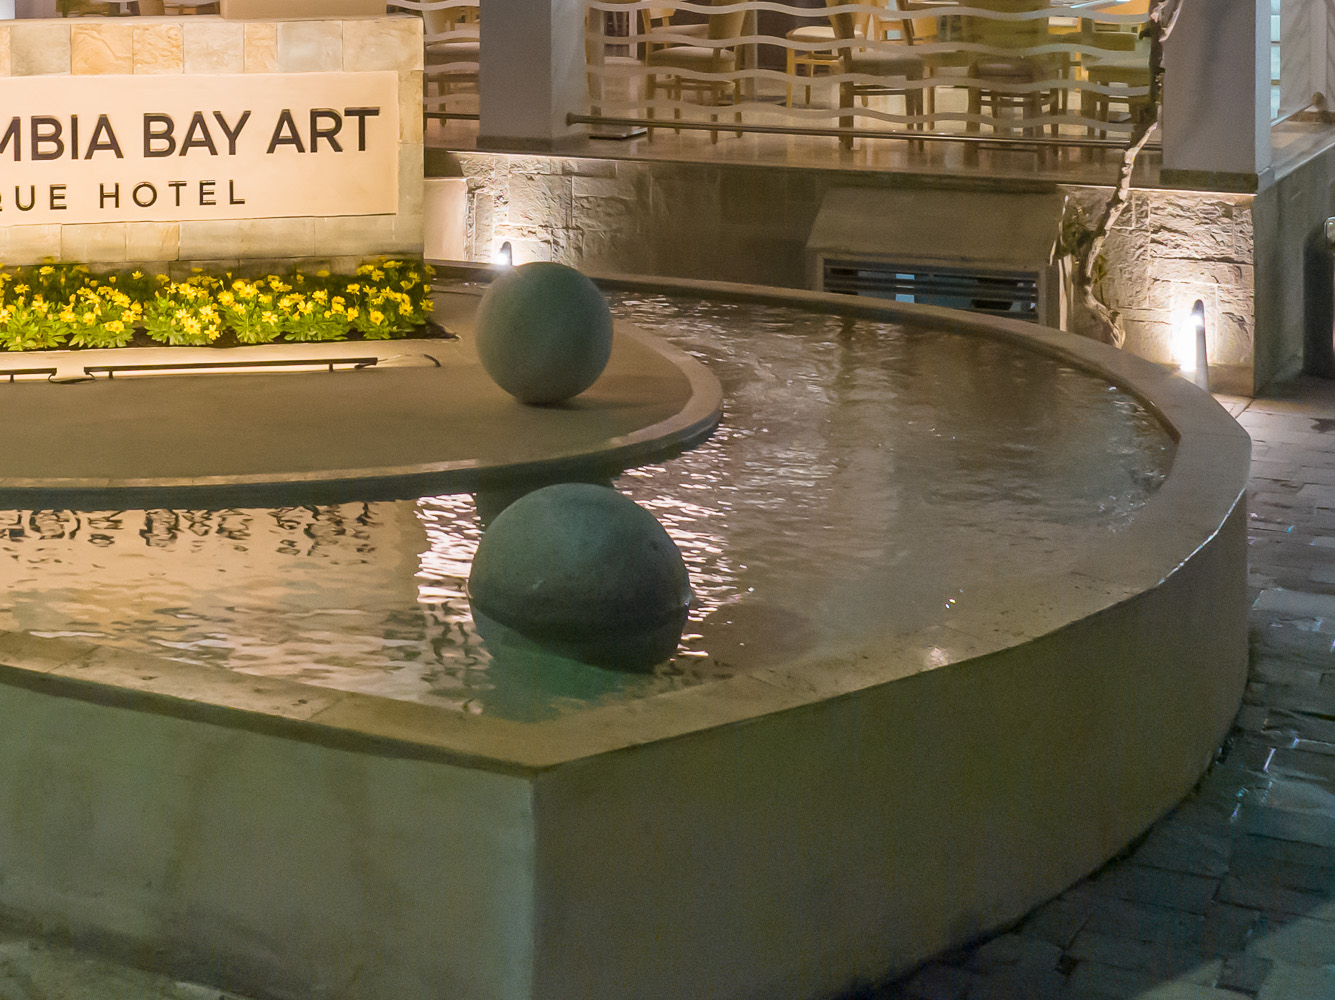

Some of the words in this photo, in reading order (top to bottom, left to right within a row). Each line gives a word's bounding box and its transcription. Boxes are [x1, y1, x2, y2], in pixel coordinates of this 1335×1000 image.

[142, 109, 252, 158] BAY
[266, 105, 381, 155] ART
[99, 179, 246, 209] HOTEL
